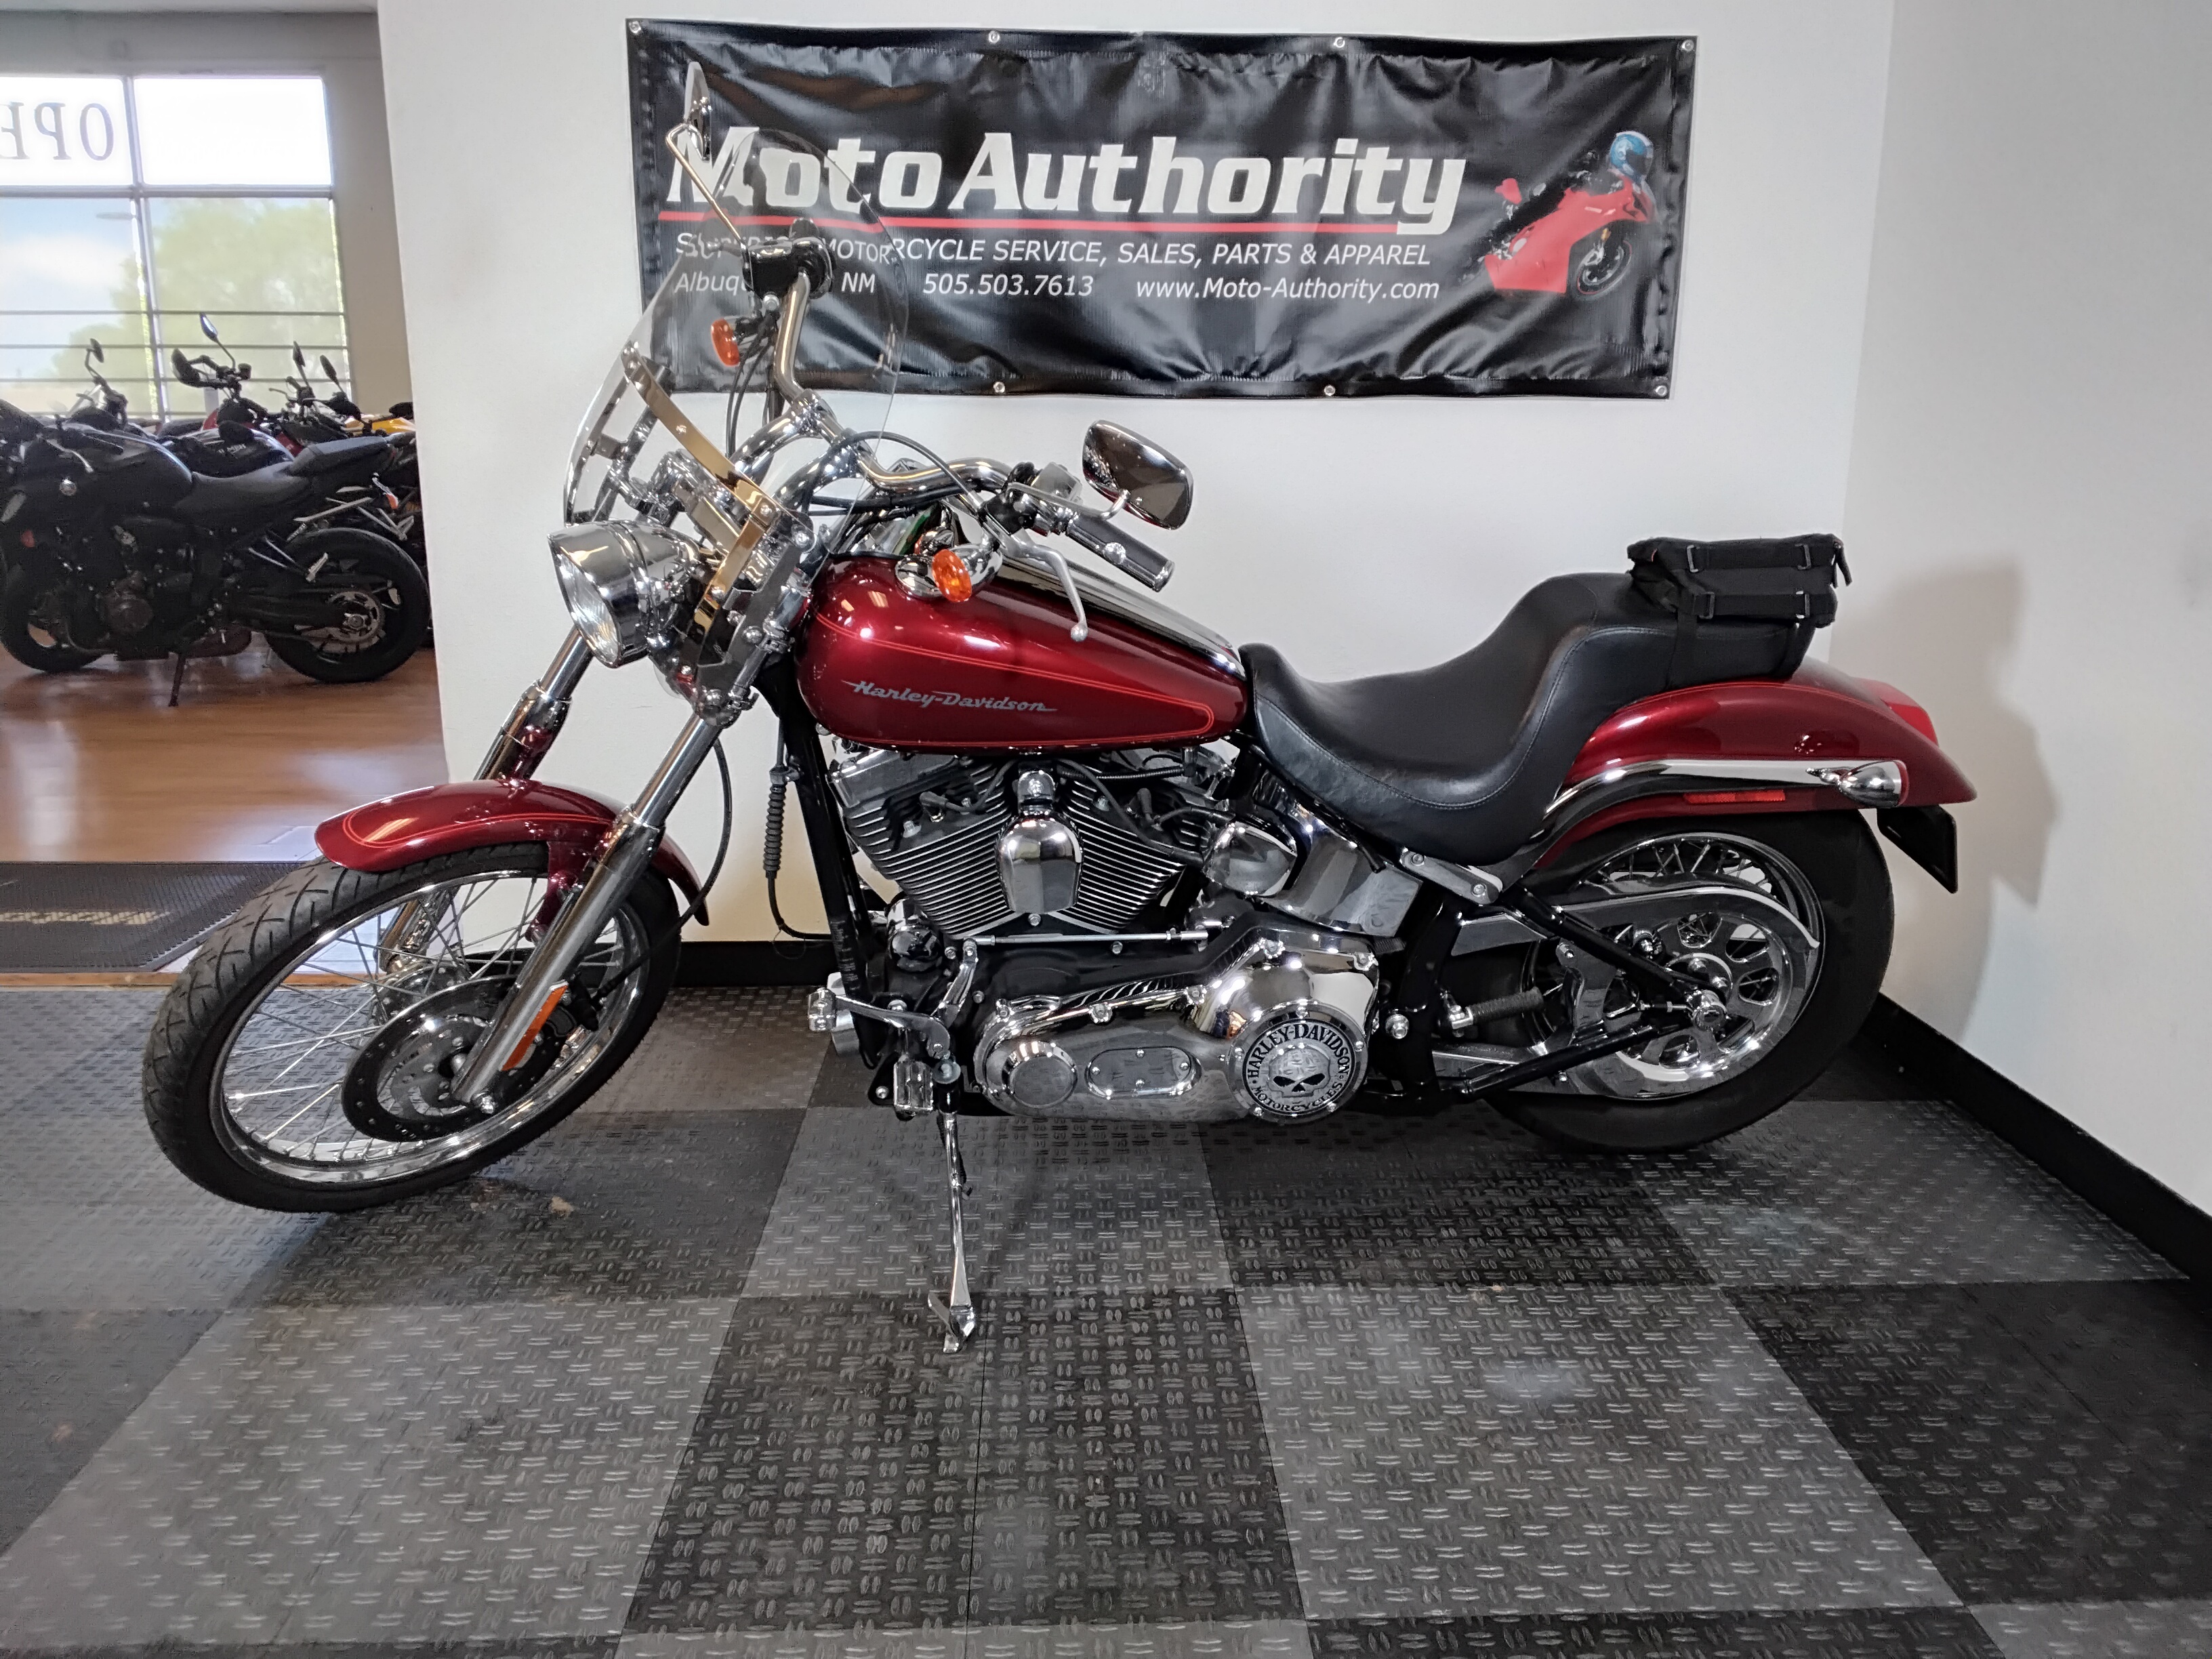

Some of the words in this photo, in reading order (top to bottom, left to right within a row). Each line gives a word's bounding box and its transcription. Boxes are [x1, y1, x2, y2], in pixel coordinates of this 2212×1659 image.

[993, 239, 1107, 267] SERVICE,
[1118, 243, 1202, 268] SALES,
[1212, 243, 1292, 264] PARTS
[1300, 244, 1317, 264] &
[1324, 244, 1431, 266] APPAREL
[841, 272, 876, 293] NM
[923, 273, 1093, 296] 505.503.7613
[1136, 277, 1439, 303] www.Moto-Authority.com
[841, 680, 1058, 712] Harley-Davidson
[1248, 1023, 1350, 1079] HARLEY-DAVIDSON
[1252, 1082, 1343, 1112] MOTORCYCLES
